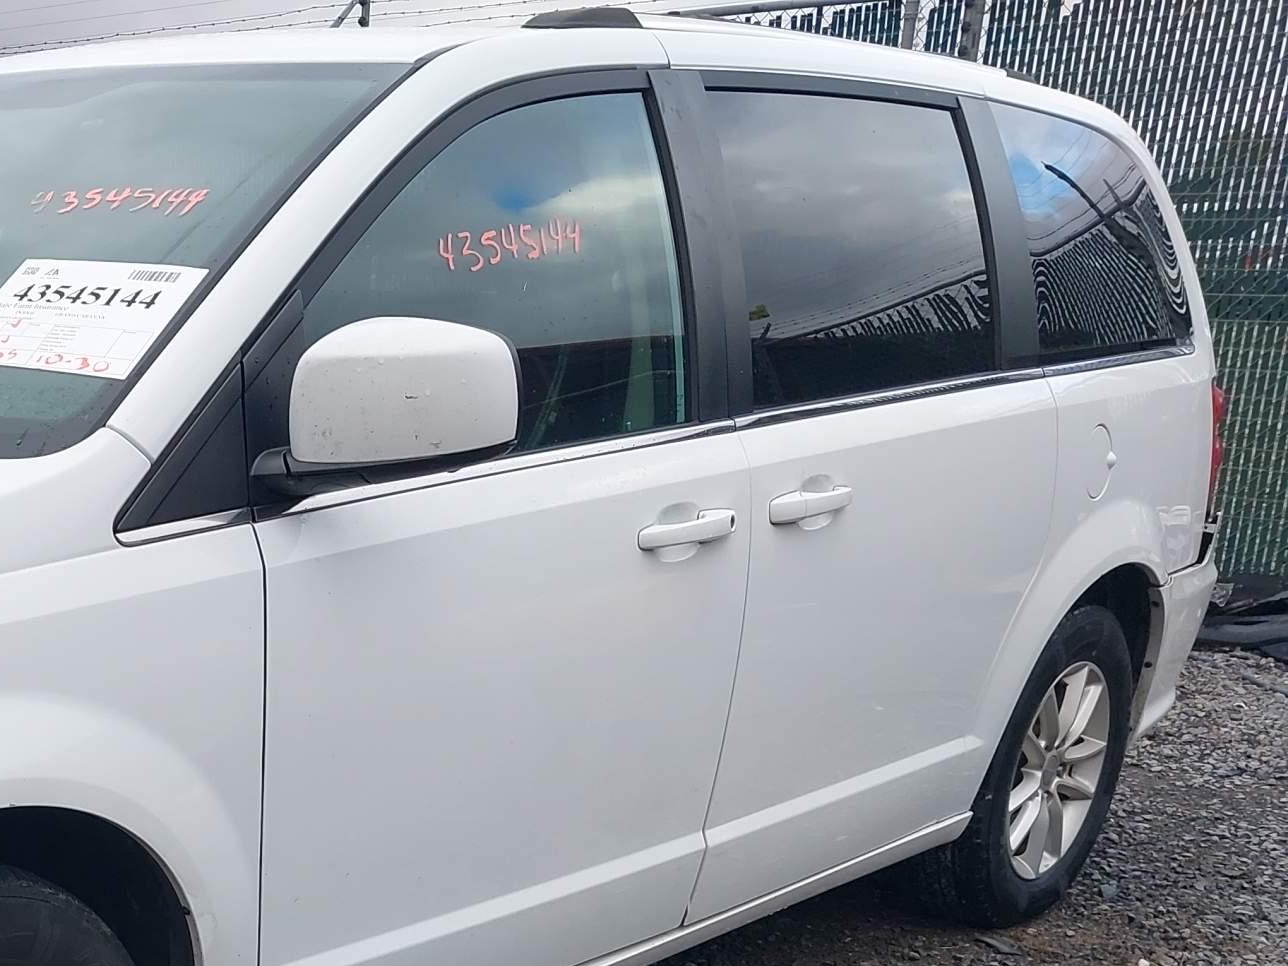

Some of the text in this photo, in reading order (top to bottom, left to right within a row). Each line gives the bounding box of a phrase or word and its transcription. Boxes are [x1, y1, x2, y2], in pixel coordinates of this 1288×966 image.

[31, 187, 210, 216] 43545144
[439, 218, 581, 271] 43545144
[13, 283, 162, 309] 43545144
